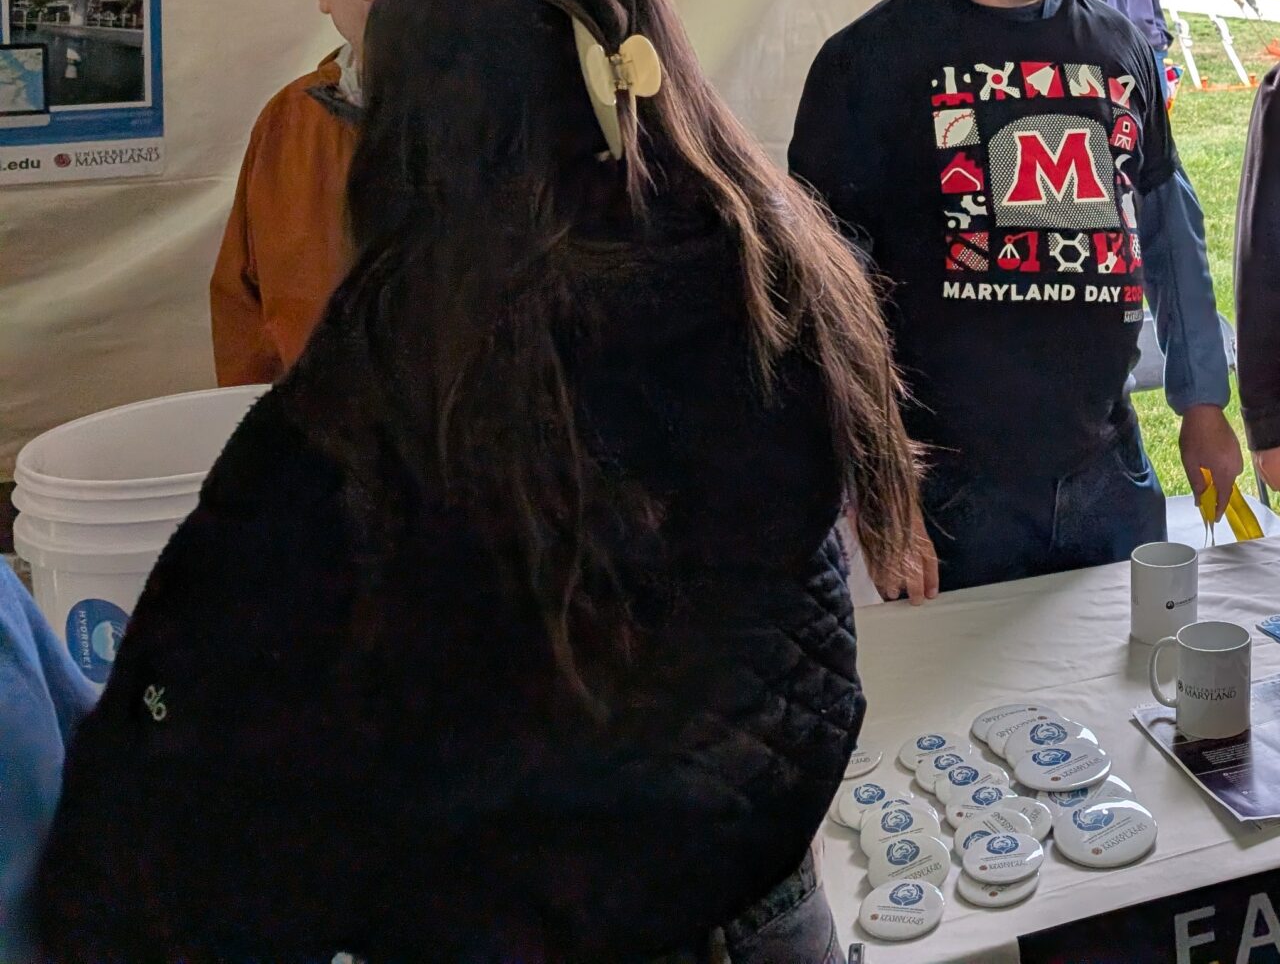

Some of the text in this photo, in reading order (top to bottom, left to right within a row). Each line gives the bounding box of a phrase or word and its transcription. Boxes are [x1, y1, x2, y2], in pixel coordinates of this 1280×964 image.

[0, 158, 41, 171] .edu
[75, 152, 160, 167] MARYLAND
[1003, 128, 1109, 205] M
[943, 281, 1076, 302] MARYLAND
[1084, 285, 1121, 303] DAY
